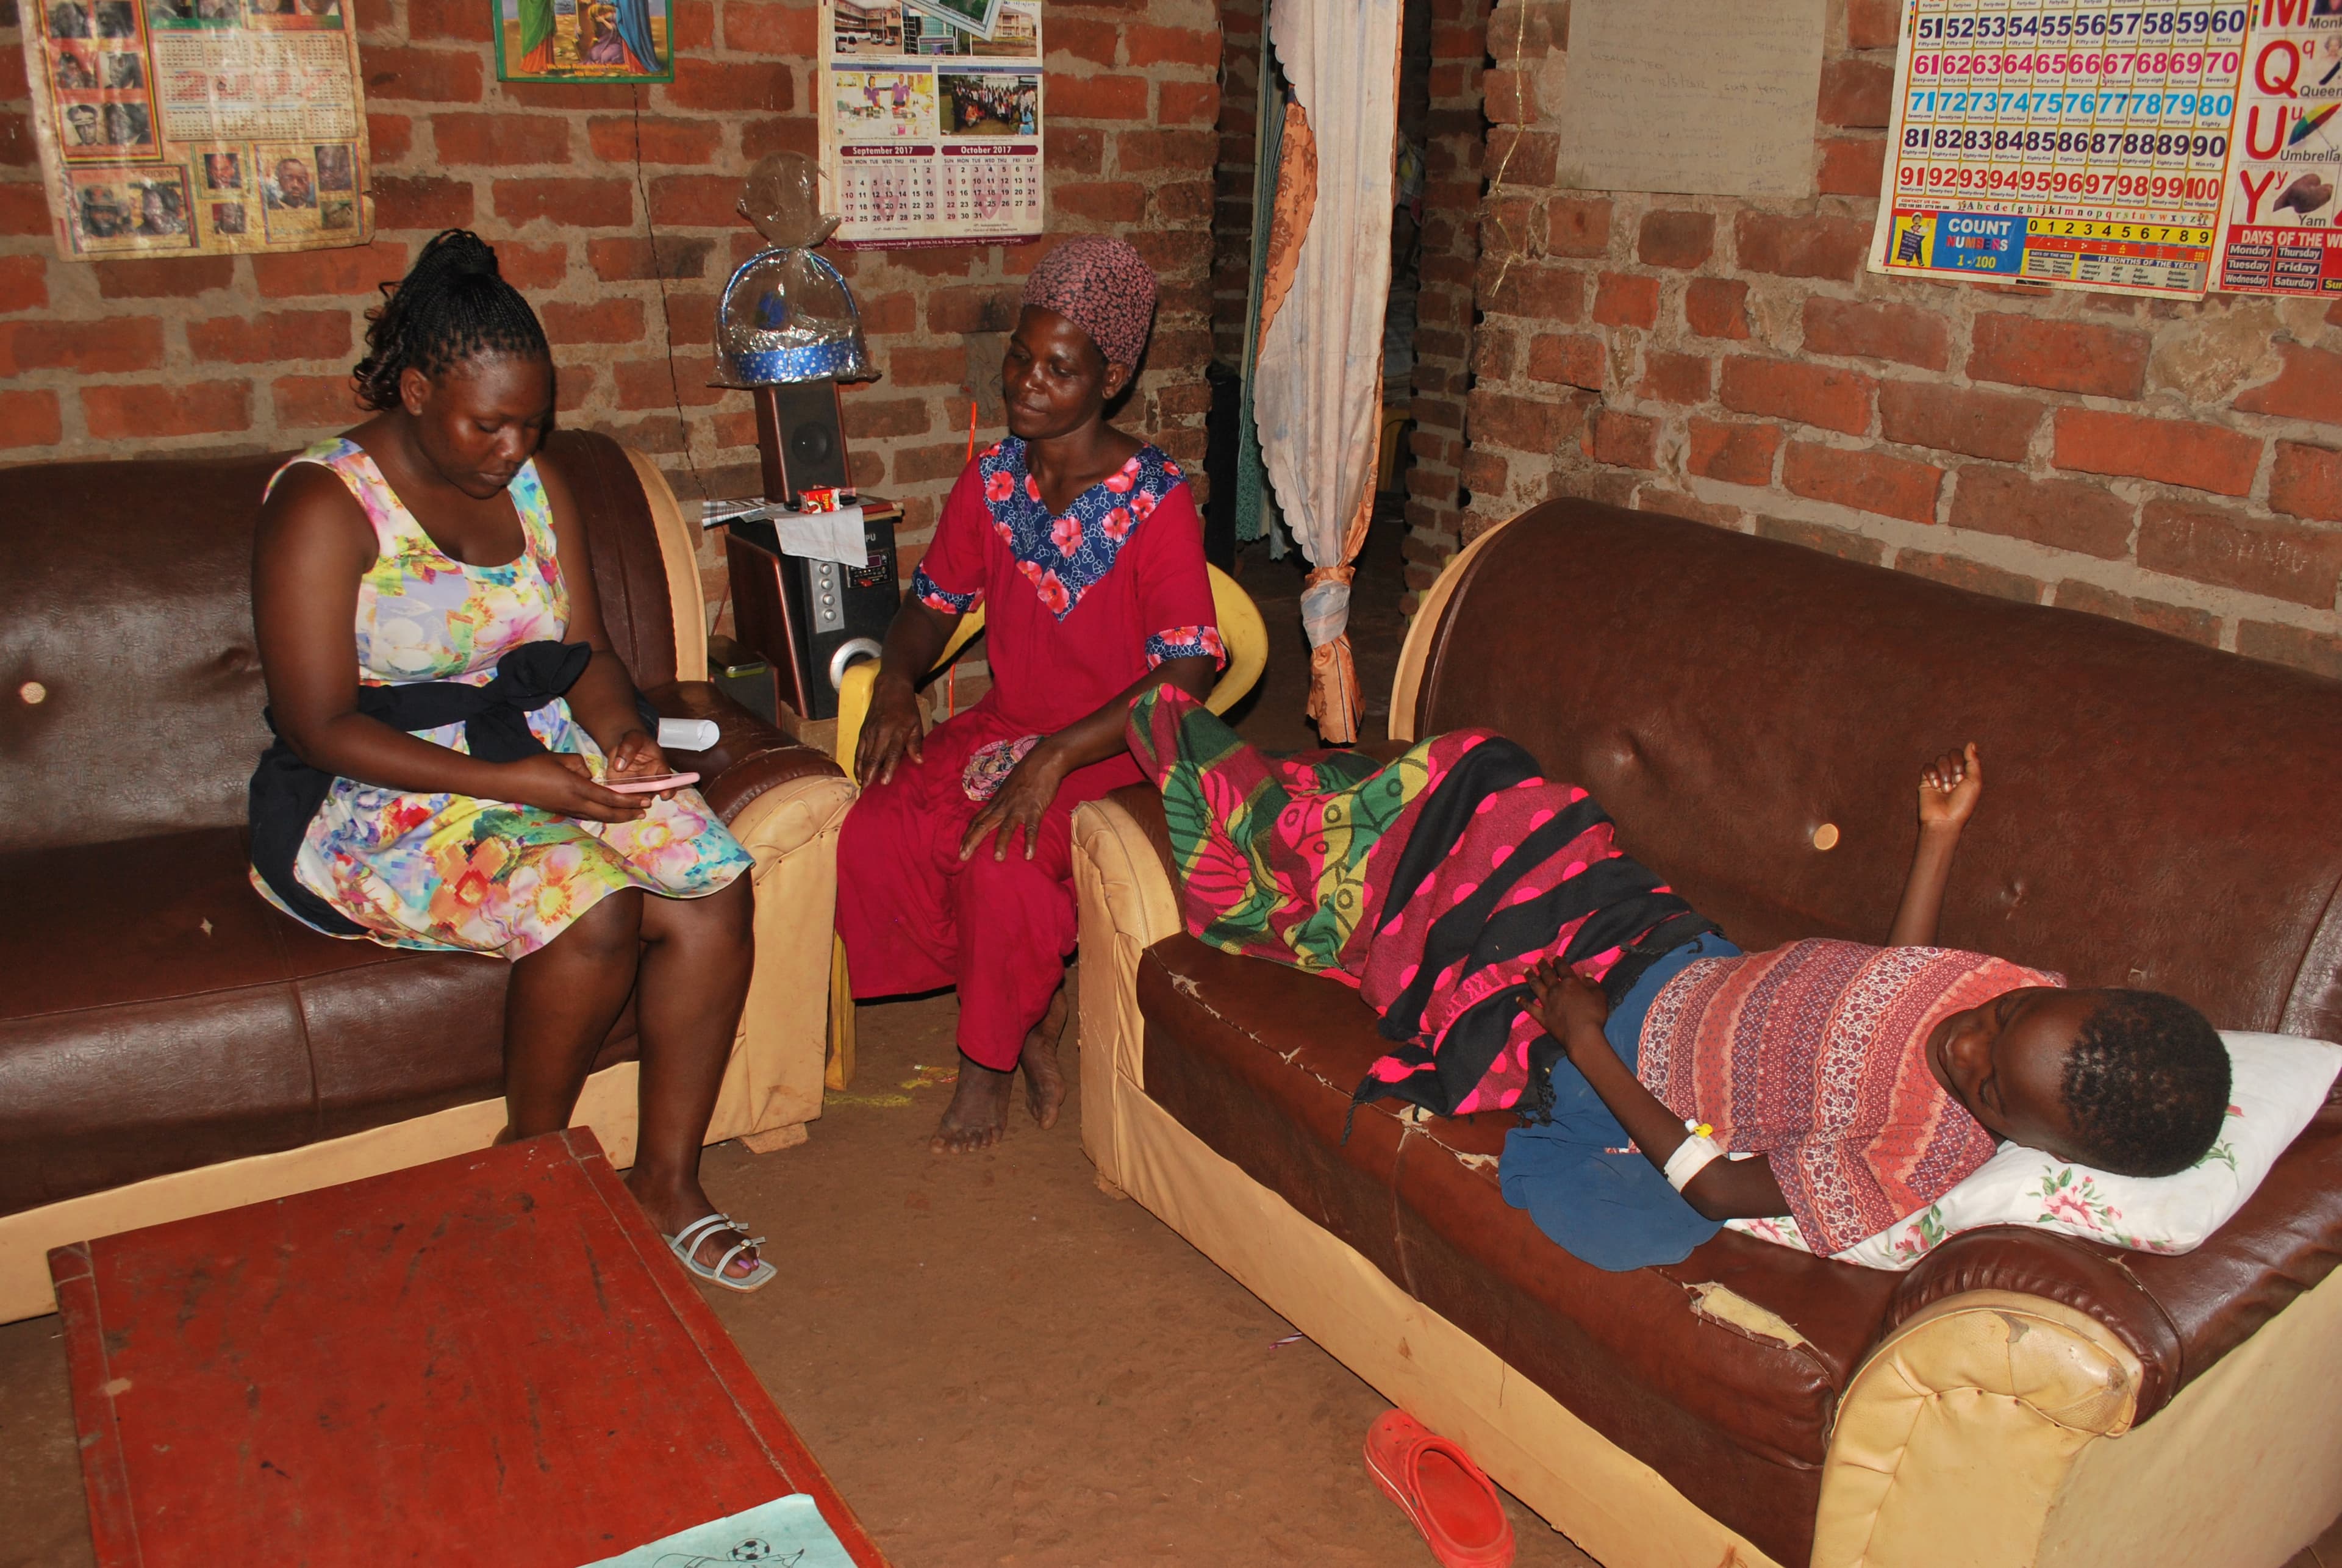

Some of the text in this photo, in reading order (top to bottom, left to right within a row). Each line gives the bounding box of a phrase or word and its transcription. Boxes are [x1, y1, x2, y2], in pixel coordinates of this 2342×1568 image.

[1919, 10, 2244, 38] 51 52 53 54 55 56 57 58 59 60
[1914, 52, 2238, 75] 61 62 63 64 65 66 67 68 69 70
[2254, 40, 2315, 99] Q q
[2300, 85, 2342, 98] Queen
[1911, 91, 2232, 116] 71 72 73 74 75 76 77 78 79 80
[2245, 106, 2303, 160] U u
[853, 146, 893, 156] September
[1905, 129, 2226, 157] 81 82 83 84 85 86 87 88 89 90
[2280, 149, 2341, 162] Umbrella
[1900, 167, 2219, 201] 91 92 93 94 95 96 97 98 99 100
[2240, 170, 2288, 224] Y y
[1948, 218, 2011, 236] COUNT
[2298, 215, 2326, 226] Yam
[2030, 220, 2209, 243] 0 1 2 3 4 5 6 7 8 9
[2242, 230, 2274, 245] DAYS
[2277, 231, 2296, 245] OF
[2298, 232, 2323, 247] THE
[1946, 236, 2008, 251] NUMBERS
[2230, 245, 2320, 259] Monday Thursday
[1957, 254, 1964, 266] 1
[1975, 256, 1996, 269] 100
[2108, 257, 2141, 265] MONTHS
[2228, 260, 2316, 274] Tuesday Friday
[2226, 274, 2315, 289] Wednesday Saturday
